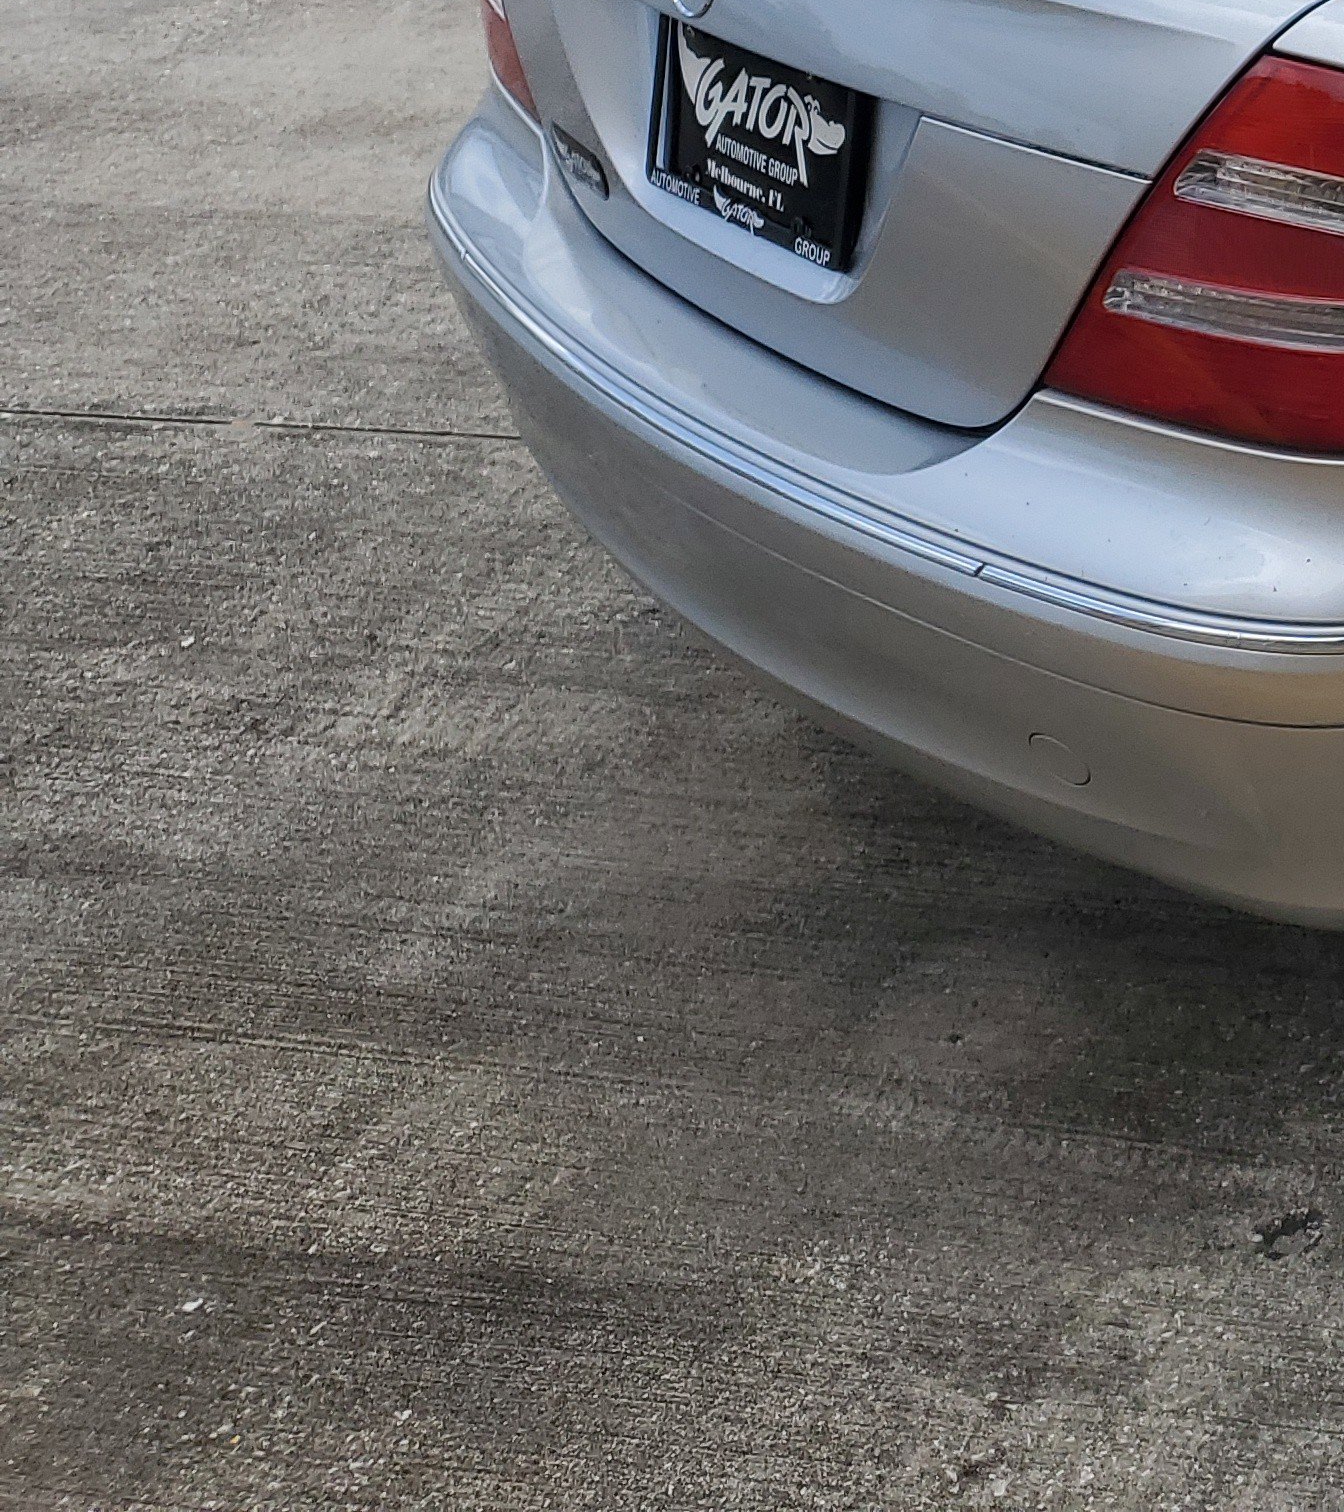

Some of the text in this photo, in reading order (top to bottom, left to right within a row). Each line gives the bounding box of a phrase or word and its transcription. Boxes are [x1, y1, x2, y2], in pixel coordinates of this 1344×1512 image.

[695, 57, 810, 188] GATOR
[715, 133, 799, 187] AUTOMOTIVE GROUP
[650, 169, 702, 206] AUTOMOTIVE
[721, 197, 758, 236] GATOR
[794, 236, 832, 267] GROUP
